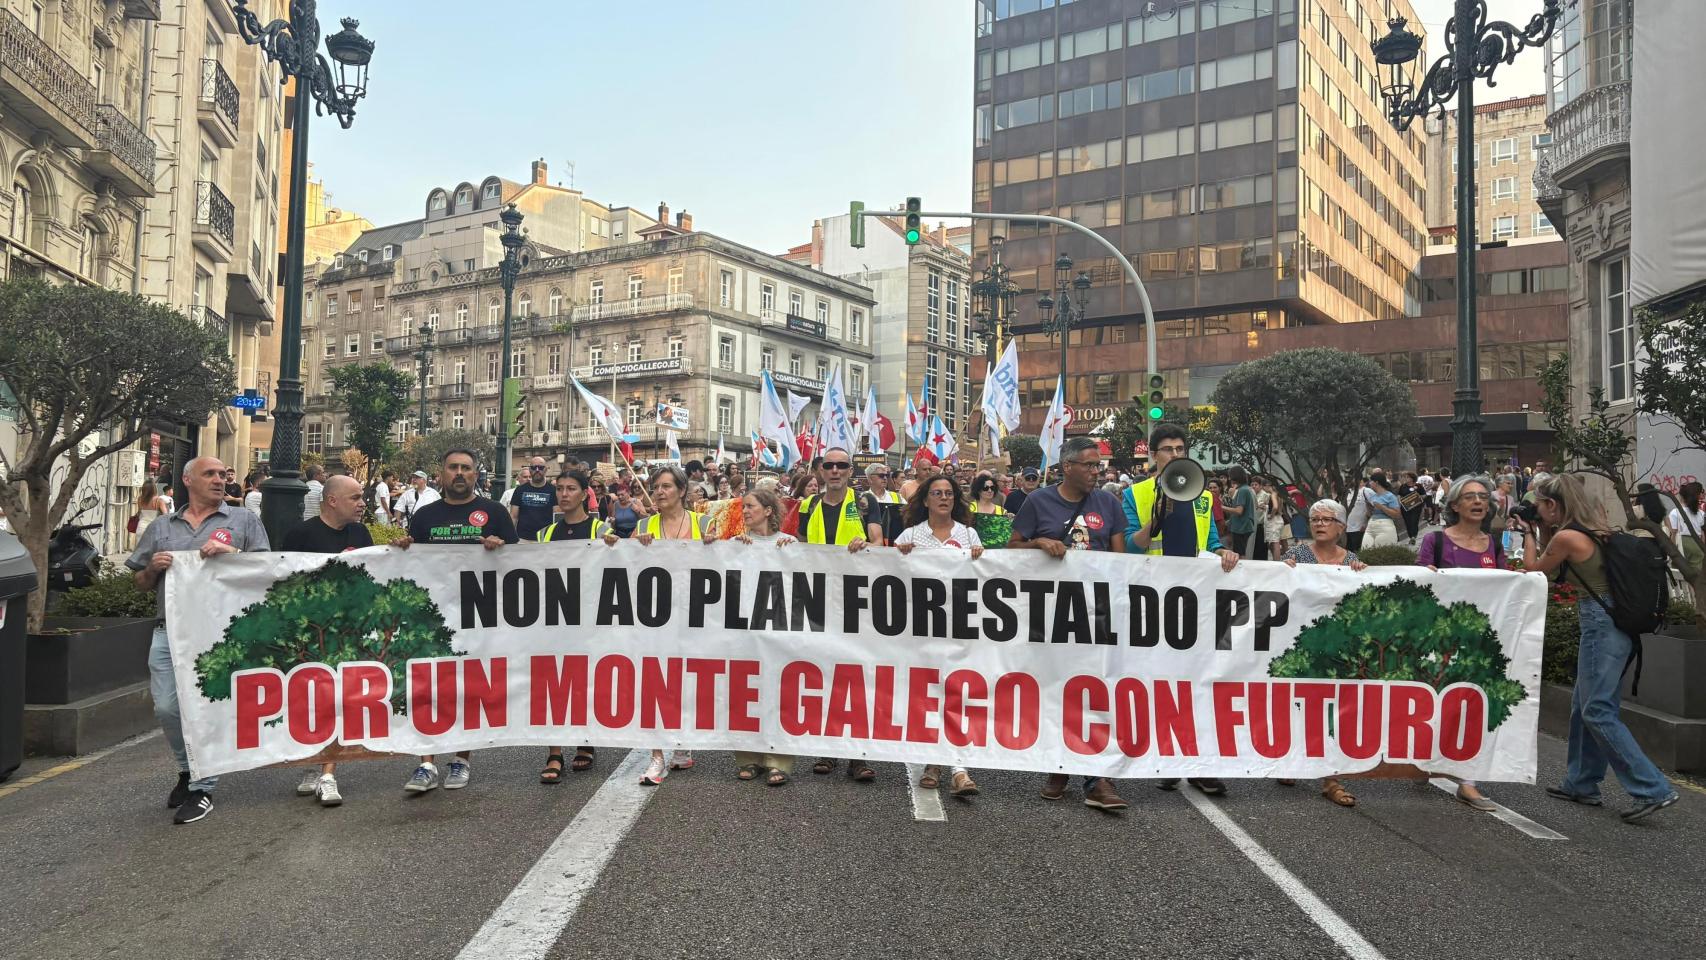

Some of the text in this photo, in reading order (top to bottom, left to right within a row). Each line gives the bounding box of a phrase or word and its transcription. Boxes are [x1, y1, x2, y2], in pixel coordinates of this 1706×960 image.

[594, 359, 680, 375] COMERCIOGALLEGO.ES
[236, 397, 264, 407] 20:17
[460, 566, 1290, 651] NON AO PLAN FORESTAL DO PP
[236, 654, 1484, 762] POR UN MONTE GALEGO CON FUTURO
